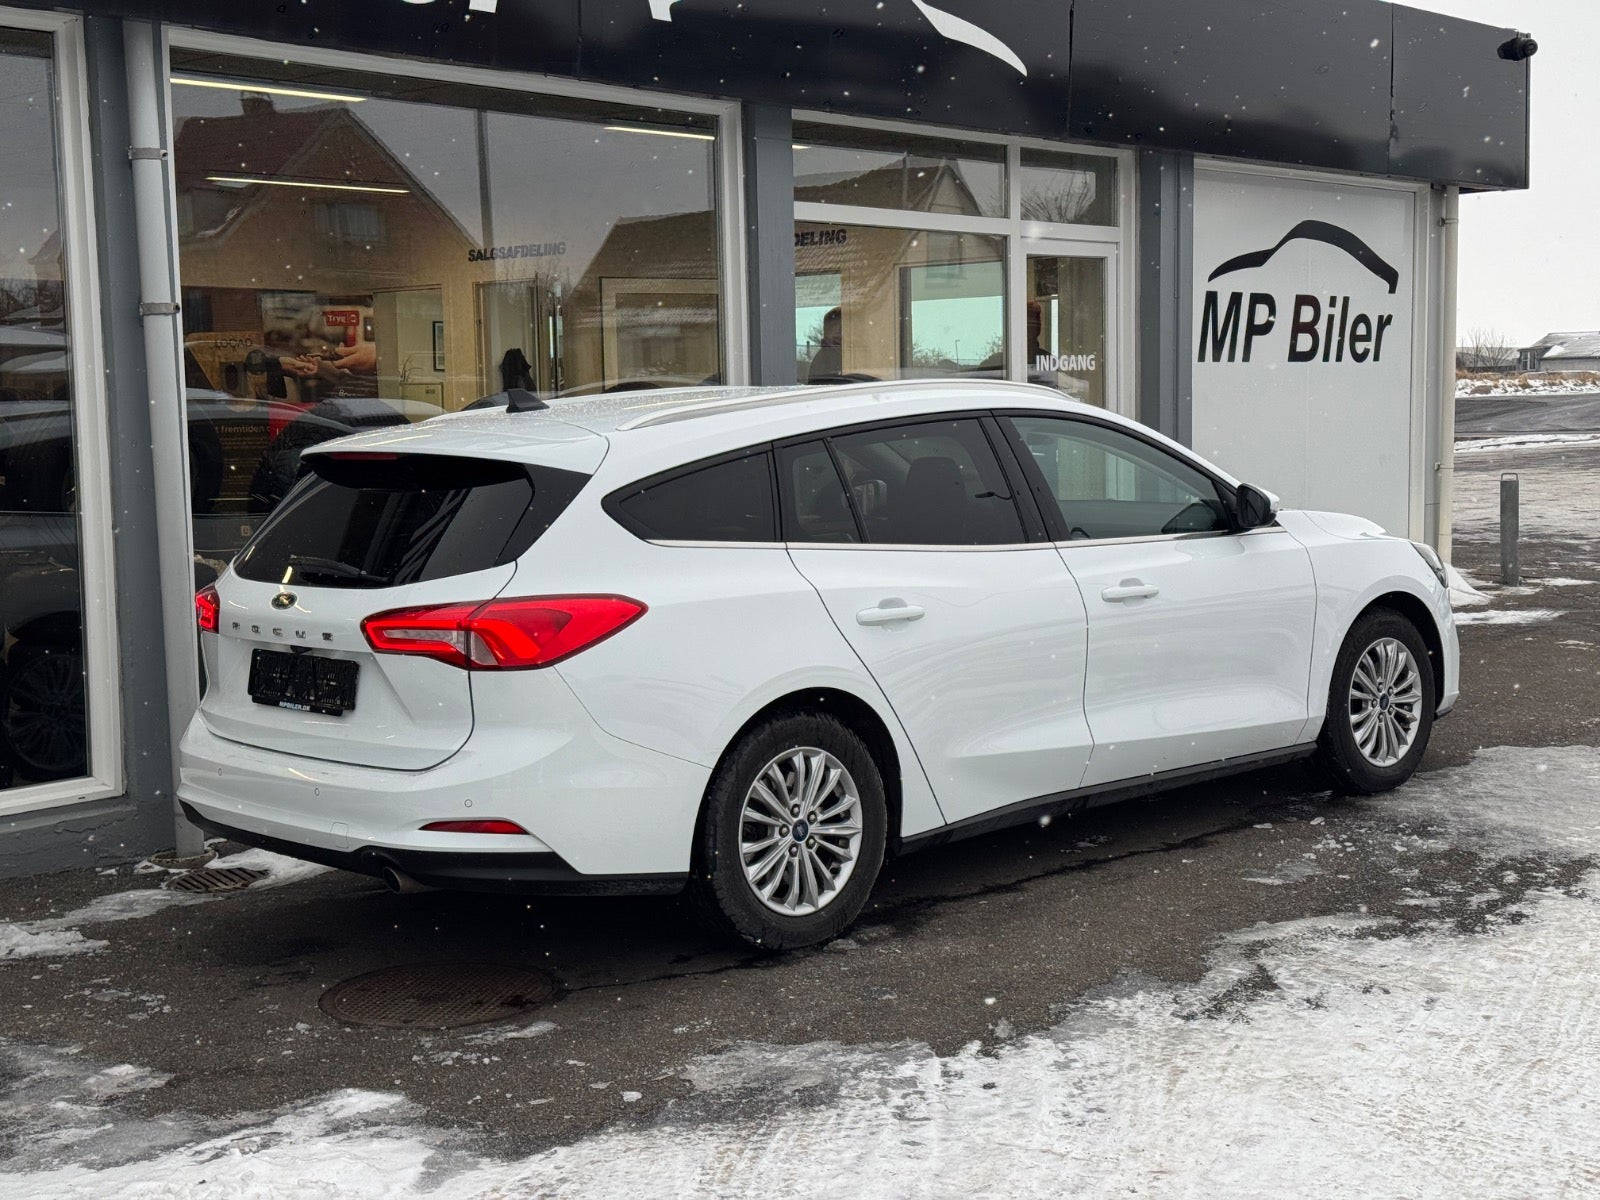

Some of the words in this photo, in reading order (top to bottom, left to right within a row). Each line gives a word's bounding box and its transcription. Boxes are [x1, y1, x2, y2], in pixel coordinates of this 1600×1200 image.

[468, 241, 566, 262] SALGSAFDELING
[327, 314, 347, 324] Tryg
[1197, 290, 1277, 363] MP
[1287, 293, 1394, 364] Biler
[1036, 354, 1096, 372] INDGANG
[221, 424, 266, 433] fremtiden
[232, 621, 334, 641] FOCUS
